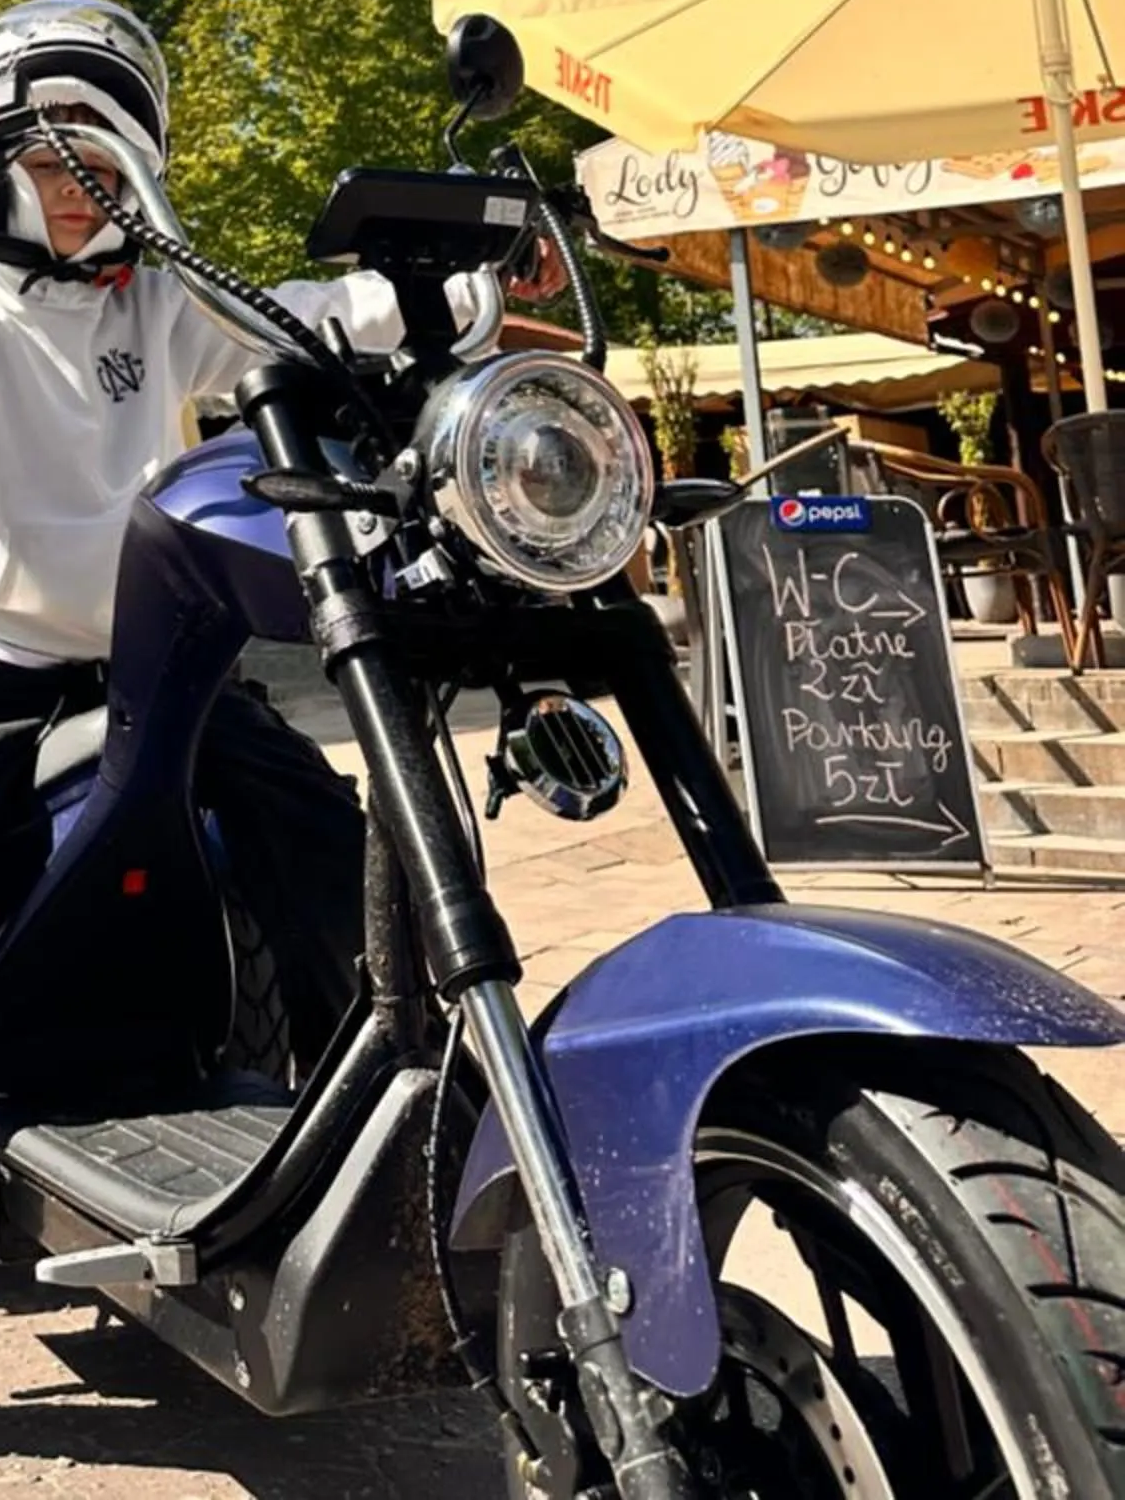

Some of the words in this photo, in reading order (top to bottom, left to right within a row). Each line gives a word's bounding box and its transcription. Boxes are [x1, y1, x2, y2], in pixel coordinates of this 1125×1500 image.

[605, 149, 699, 219] Lody
[808, 503, 862, 524] pepsi
[781, 707, 953, 773] Parking
